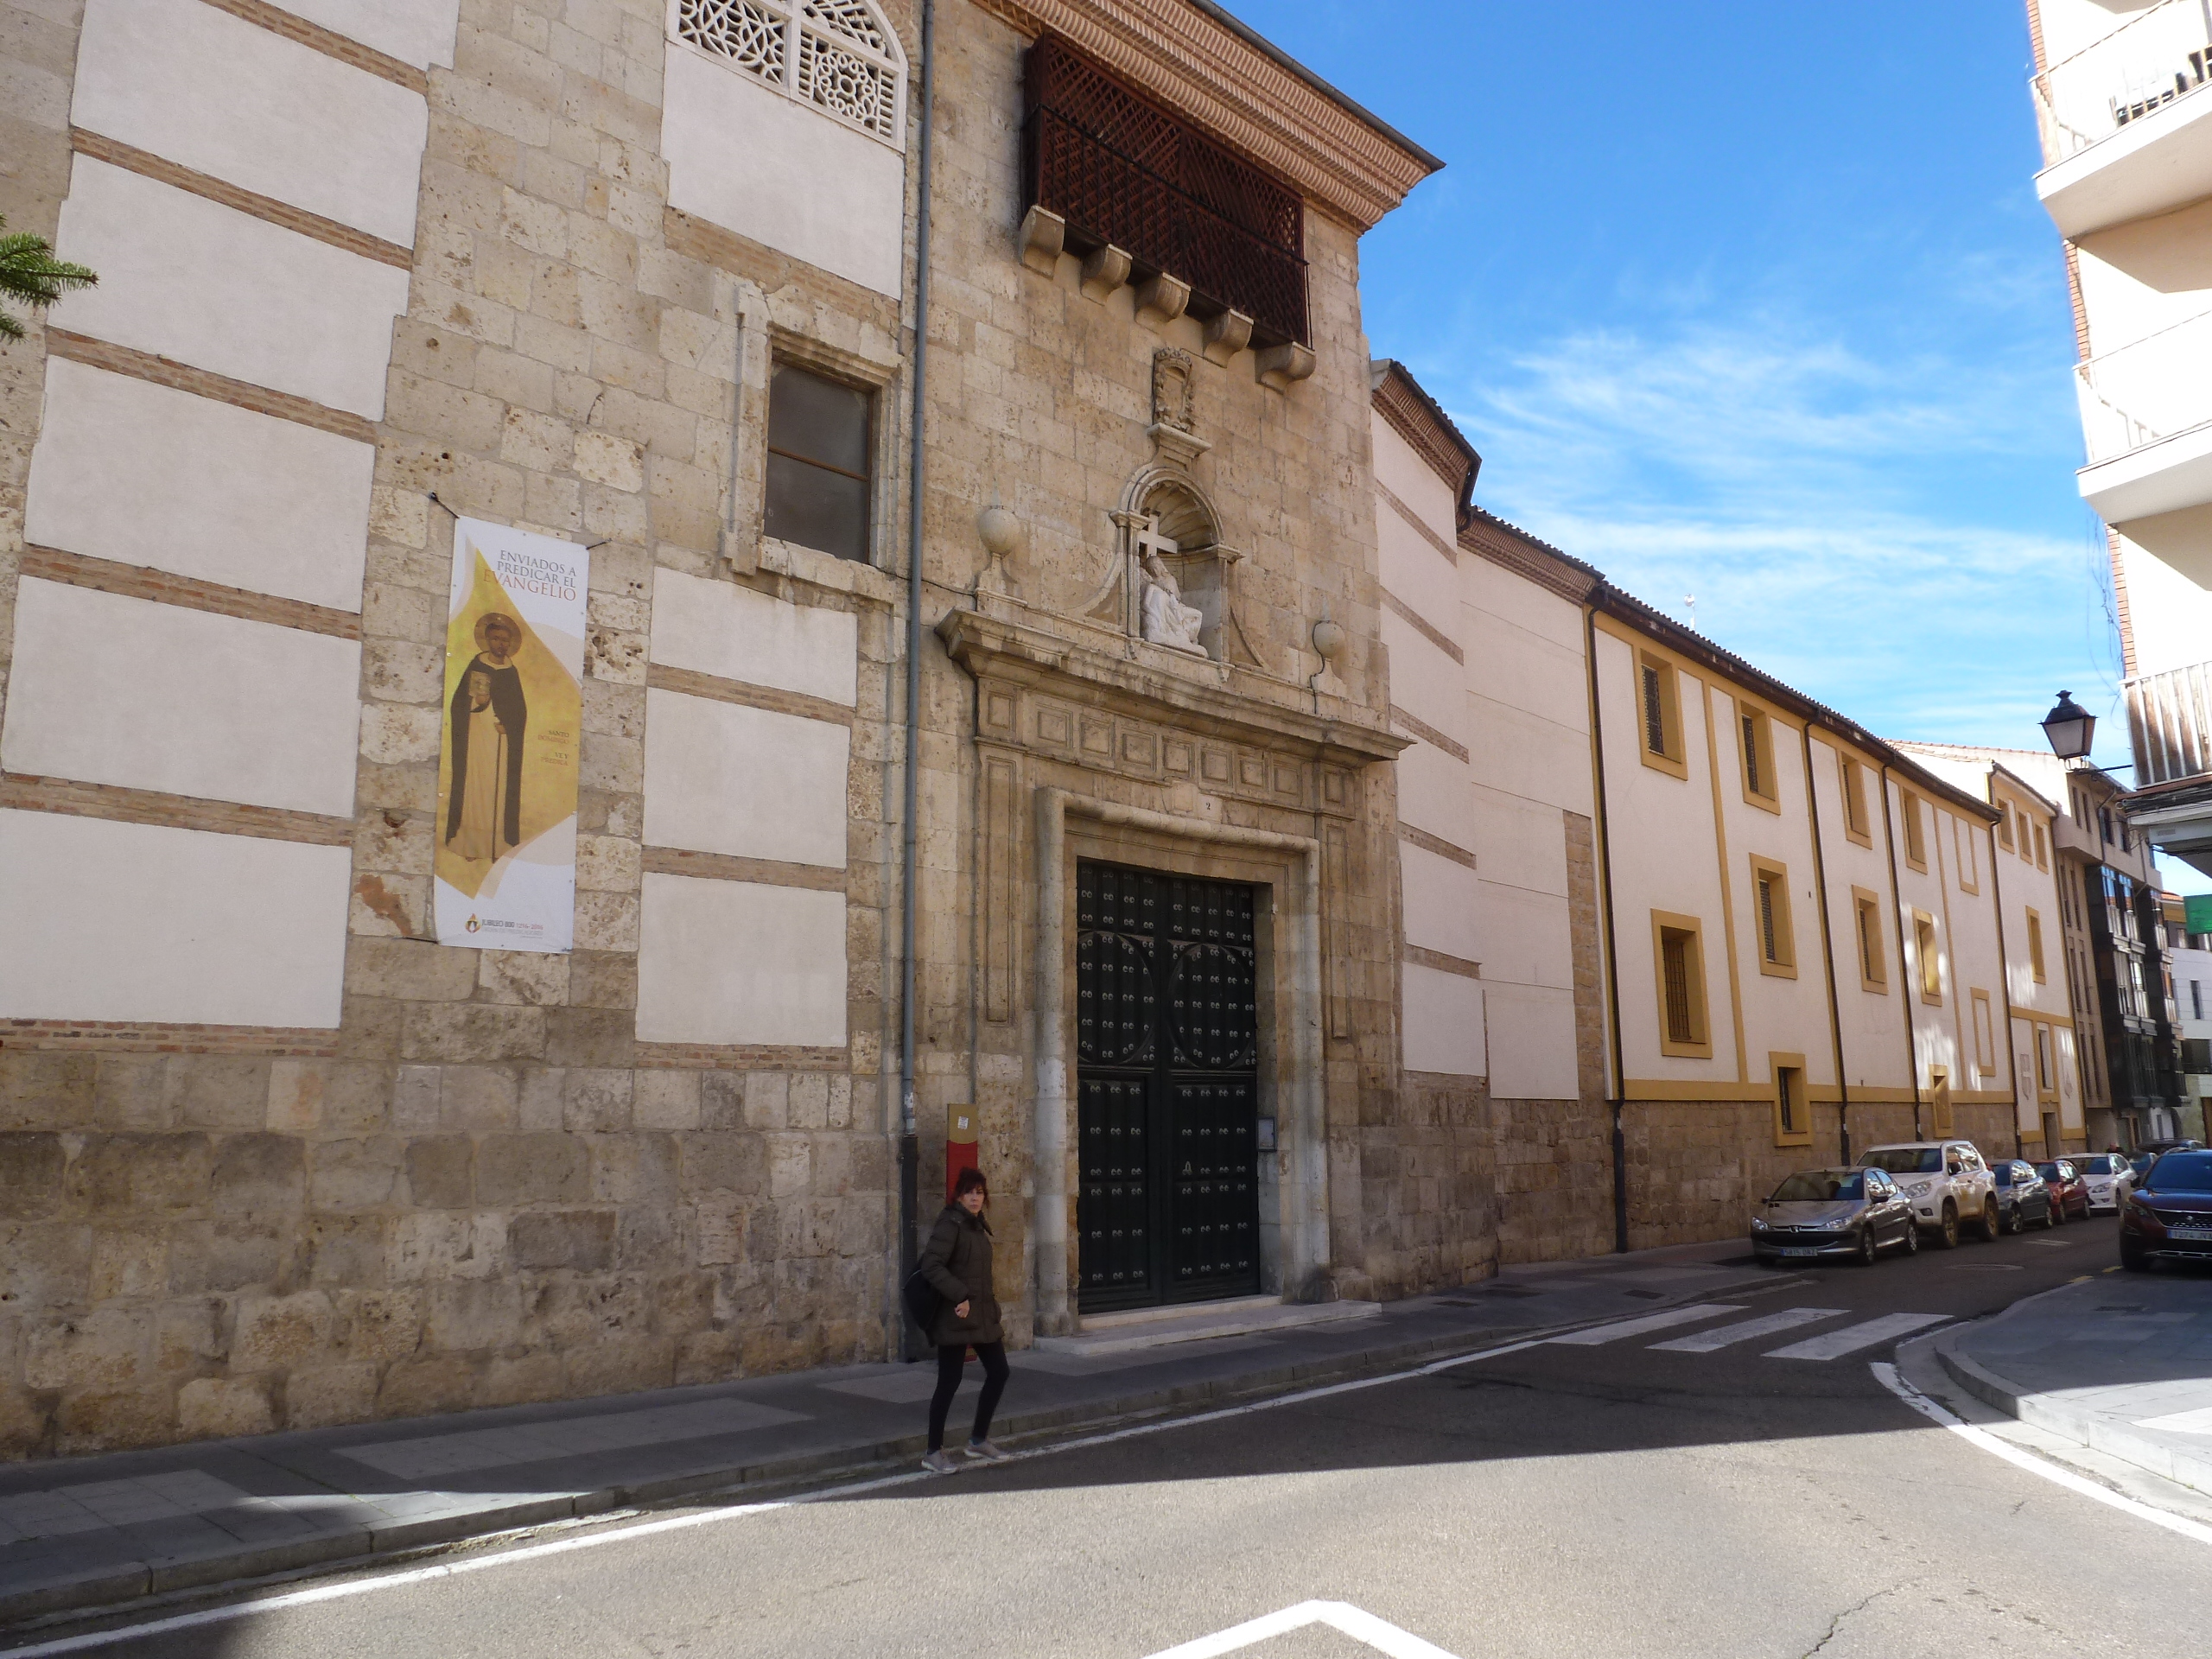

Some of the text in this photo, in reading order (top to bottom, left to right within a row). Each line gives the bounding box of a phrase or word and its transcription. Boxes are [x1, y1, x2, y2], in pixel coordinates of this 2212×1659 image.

[497, 561, 575, 588] PREDICAR EL
[500, 550, 576, 577] ENVIADOS A
[484, 569, 576, 601] EVANGELIO
